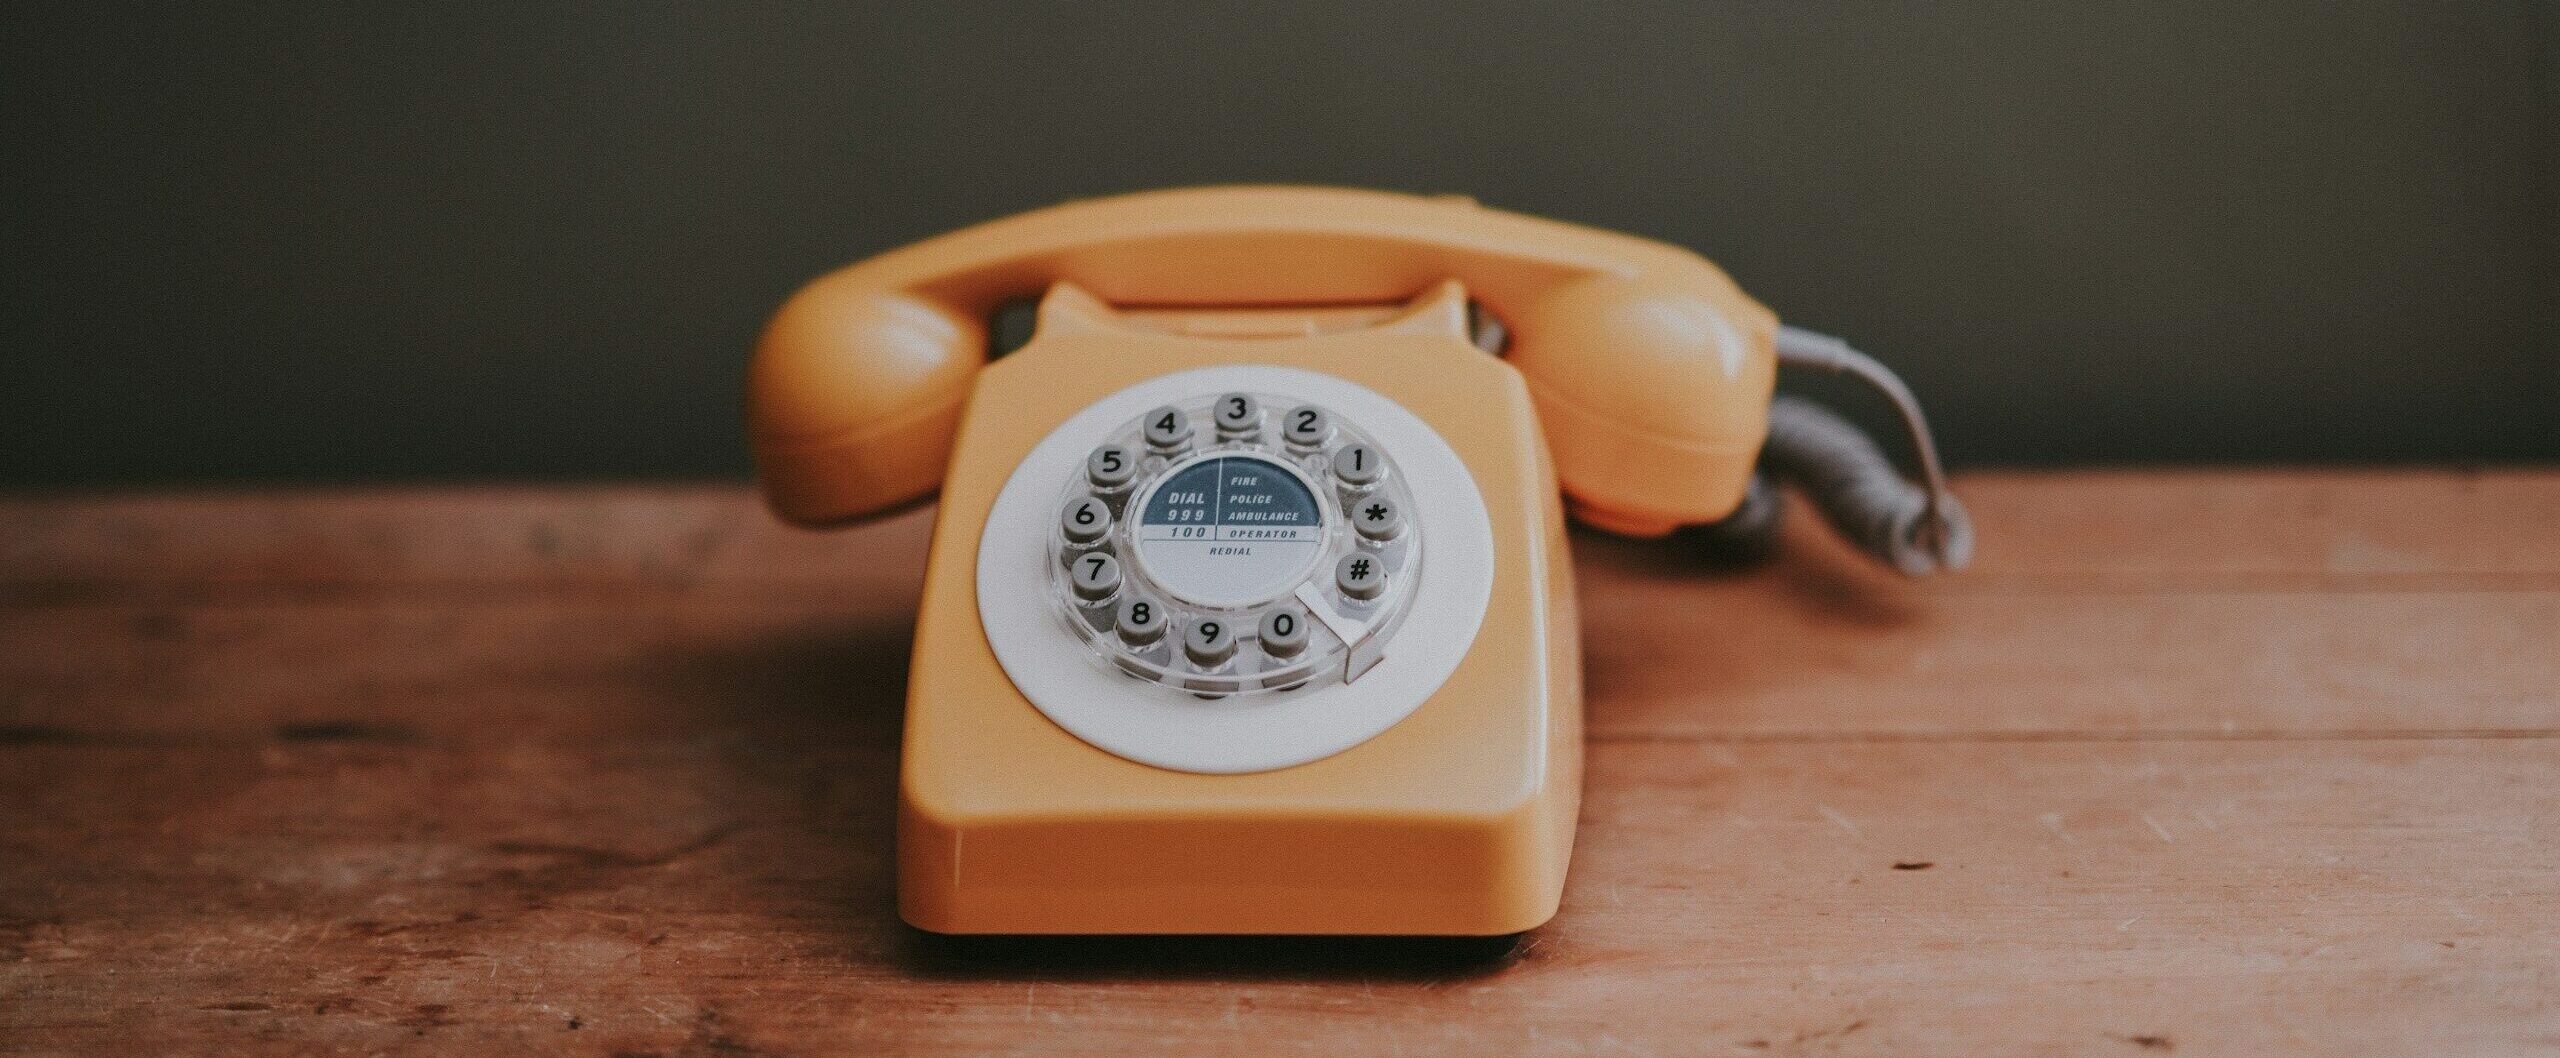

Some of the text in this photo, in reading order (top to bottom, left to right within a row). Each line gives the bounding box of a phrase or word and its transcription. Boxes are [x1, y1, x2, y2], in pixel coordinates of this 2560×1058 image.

[1228, 397, 1247, 420] 3
[1156, 412, 1176, 434] 4
[1298, 410, 1317, 432] 2
[1102, 451, 1121, 473] 5
[1353, 449, 1362, 470] 1
[1231, 477, 1257, 486] FIRE
[1169, 492, 1205, 504] DIAL
[1230, 495, 1272, 504] POLICE
[1075, 503, 1095, 525] 6
[1168, 509, 1205, 521] 999
[1228, 512, 1299, 521] AMBULANCE
[1171, 527, 1206, 538] 100
[1230, 530, 1297, 538] OPERATOR
[1209, 547, 1252, 555] REDIAL
[1086, 559, 1106, 581] 7
[1350, 560, 1370, 580] #
[1131, 602, 1150, 625] 8
[1200, 622, 1219, 644] 9
[1273, 614, 1294, 637] 0
